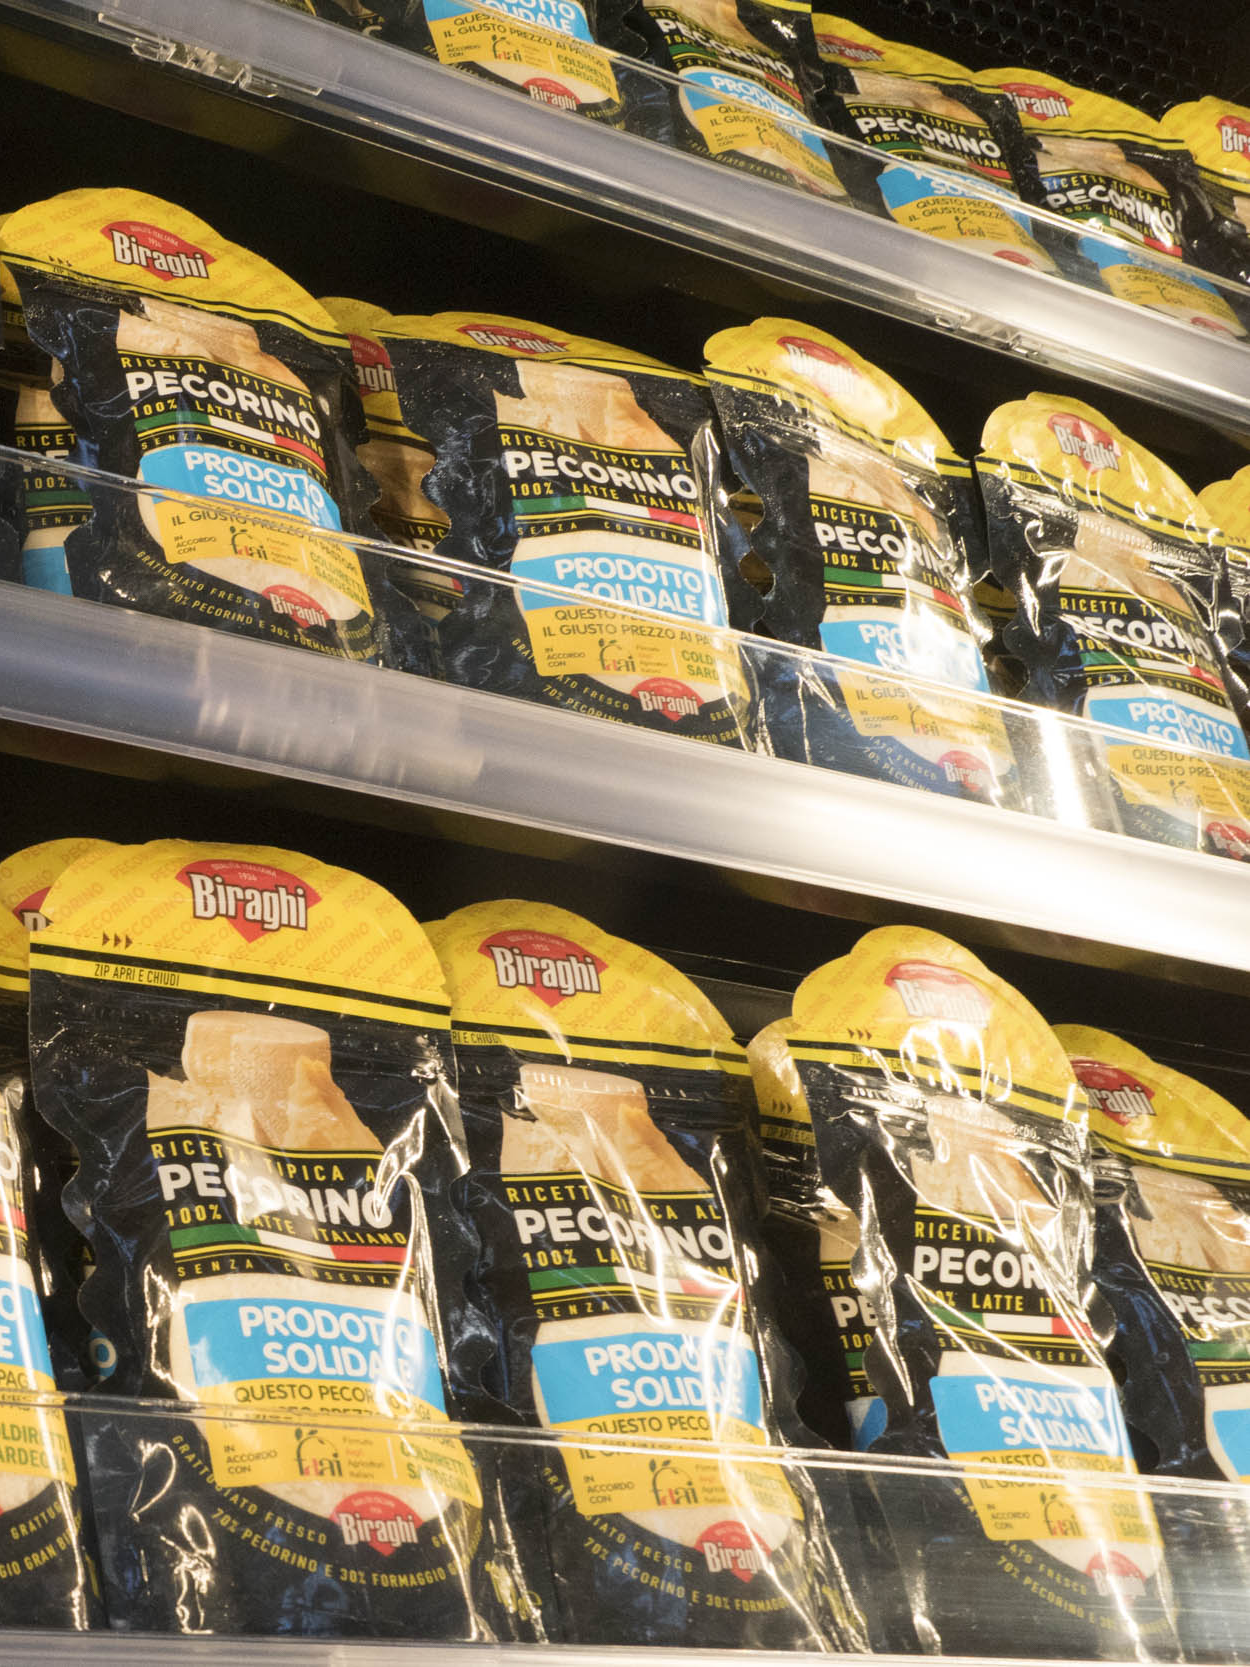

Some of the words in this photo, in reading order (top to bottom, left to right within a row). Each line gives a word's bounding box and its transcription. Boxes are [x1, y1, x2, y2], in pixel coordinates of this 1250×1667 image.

[458, 22, 507, 35] GIUSTO
[855, 117, 1002, 159] PECORINO
[112, 230, 210, 280] Biraghi
[467, 326, 569, 355] Biraghi
[121, 356, 208, 376] RICETTA
[222, 368, 284, 400] TIPICA
[125, 371, 321, 440] PECORINO
[132, 399, 178, 419] 100%
[196, 399, 244, 428] LATTE
[259, 419, 325, 461] ITALIANO
[141, 433, 204, 451] SENZA
[501, 433, 579, 457] RICETTA
[591, 452, 652, 470] TIPICA
[670, 459, 692, 473] AL
[1055, 428, 1120, 471] Biraghi
[184, 450, 325, 509] PRODOTTO
[505, 451, 699, 502] PECORINO
[509, 480, 553, 498] 100%
[572, 482, 619, 501] LATTE
[516, 521, 579, 537] SENZA
[811, 504, 878, 529] RICETTA
[822, 551, 859, 568] 100%
[555, 556, 703, 595] PRODOTTO
[191, 598, 254, 627] PECORINO
[210, 587, 261, 610] FRESCO
[270, 593, 328, 629] Biraghi
[1059, 597, 1129, 616] RICETTA
[561, 623, 619, 638] GIUSTO
[621, 626, 676, 641] PREZZO
[638, 690, 700, 717] Biraghi
[187, 871, 308, 931] Biraghi
[94, 963, 110, 978] ZIP
[111, 965, 136, 982] APRI
[146, 970, 180, 988] CHIUDI
[489, 945, 600, 995] Biraghi
[264, 1157, 345, 1183] TIPICA
[164, 1203, 223, 1228] 100%
[311, 1226, 408, 1247] ITALIANO
[696, 1204, 723, 1220] AL
[177, 1257, 255, 1278] SENZA
[522, 1249, 578, 1268] 100%
[536, 1301, 610, 1319] SENZA
[971, 1292, 1025, 1312] LATTE
[234, 1383, 313, 1404] QUESTO
[264, 1511, 328, 1546] FRESCO
[338, 1510, 419, 1548] Biraghi
[23, 1543, 59, 1571] GRAN
[211, 1508, 237, 1533] 70%
[242, 1528, 318, 1575] PECORINO
[339, 1567, 367, 1585] 30%
[372, 1567, 446, 1589] FORMAGGIO
[633, 1541, 694, 1574] FRESCO
[583, 1537, 609, 1562] 70%
[613, 1556, 687, 1599] PECORINO
[705, 1593, 731, 1611] 30%
